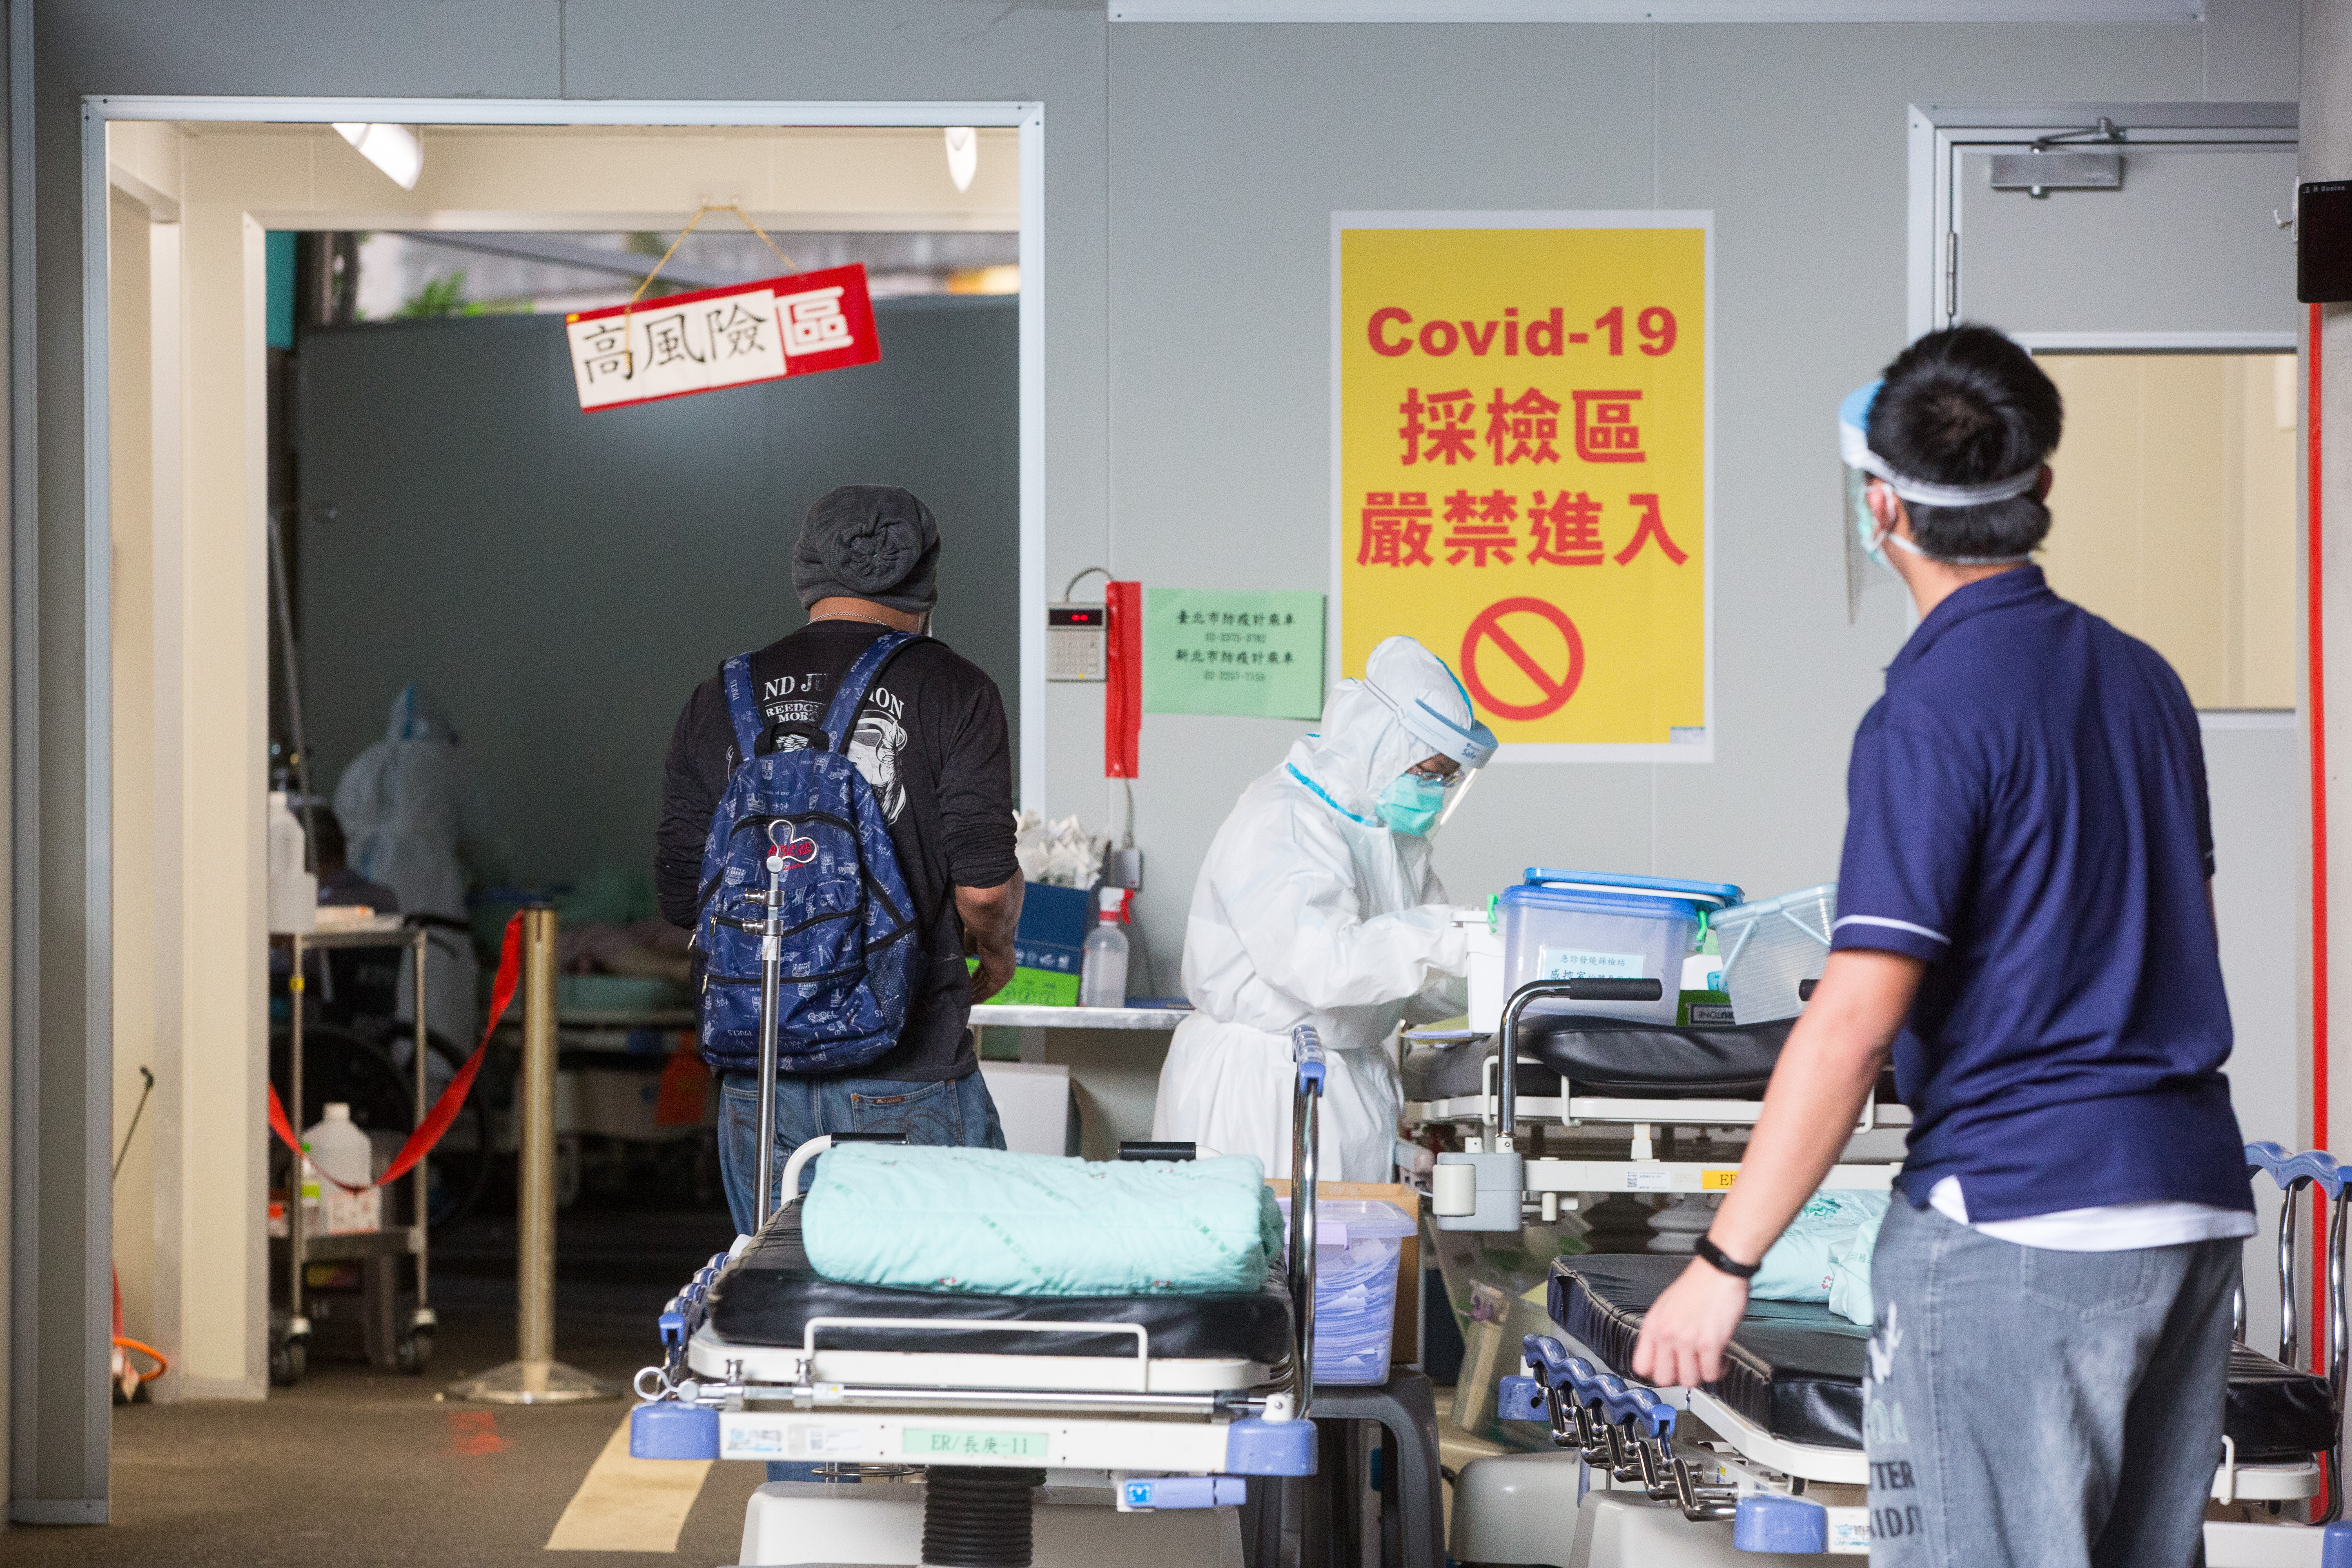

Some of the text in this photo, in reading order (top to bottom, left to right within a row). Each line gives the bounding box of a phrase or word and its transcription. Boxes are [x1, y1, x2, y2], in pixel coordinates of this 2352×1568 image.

[583, 286, 854, 385] 高風險區
[1367, 306, 1677, 357] Covid-19
[1399, 386, 1646, 466] 採檢區
[1356, 489, 1689, 567] 嚴禁進入
